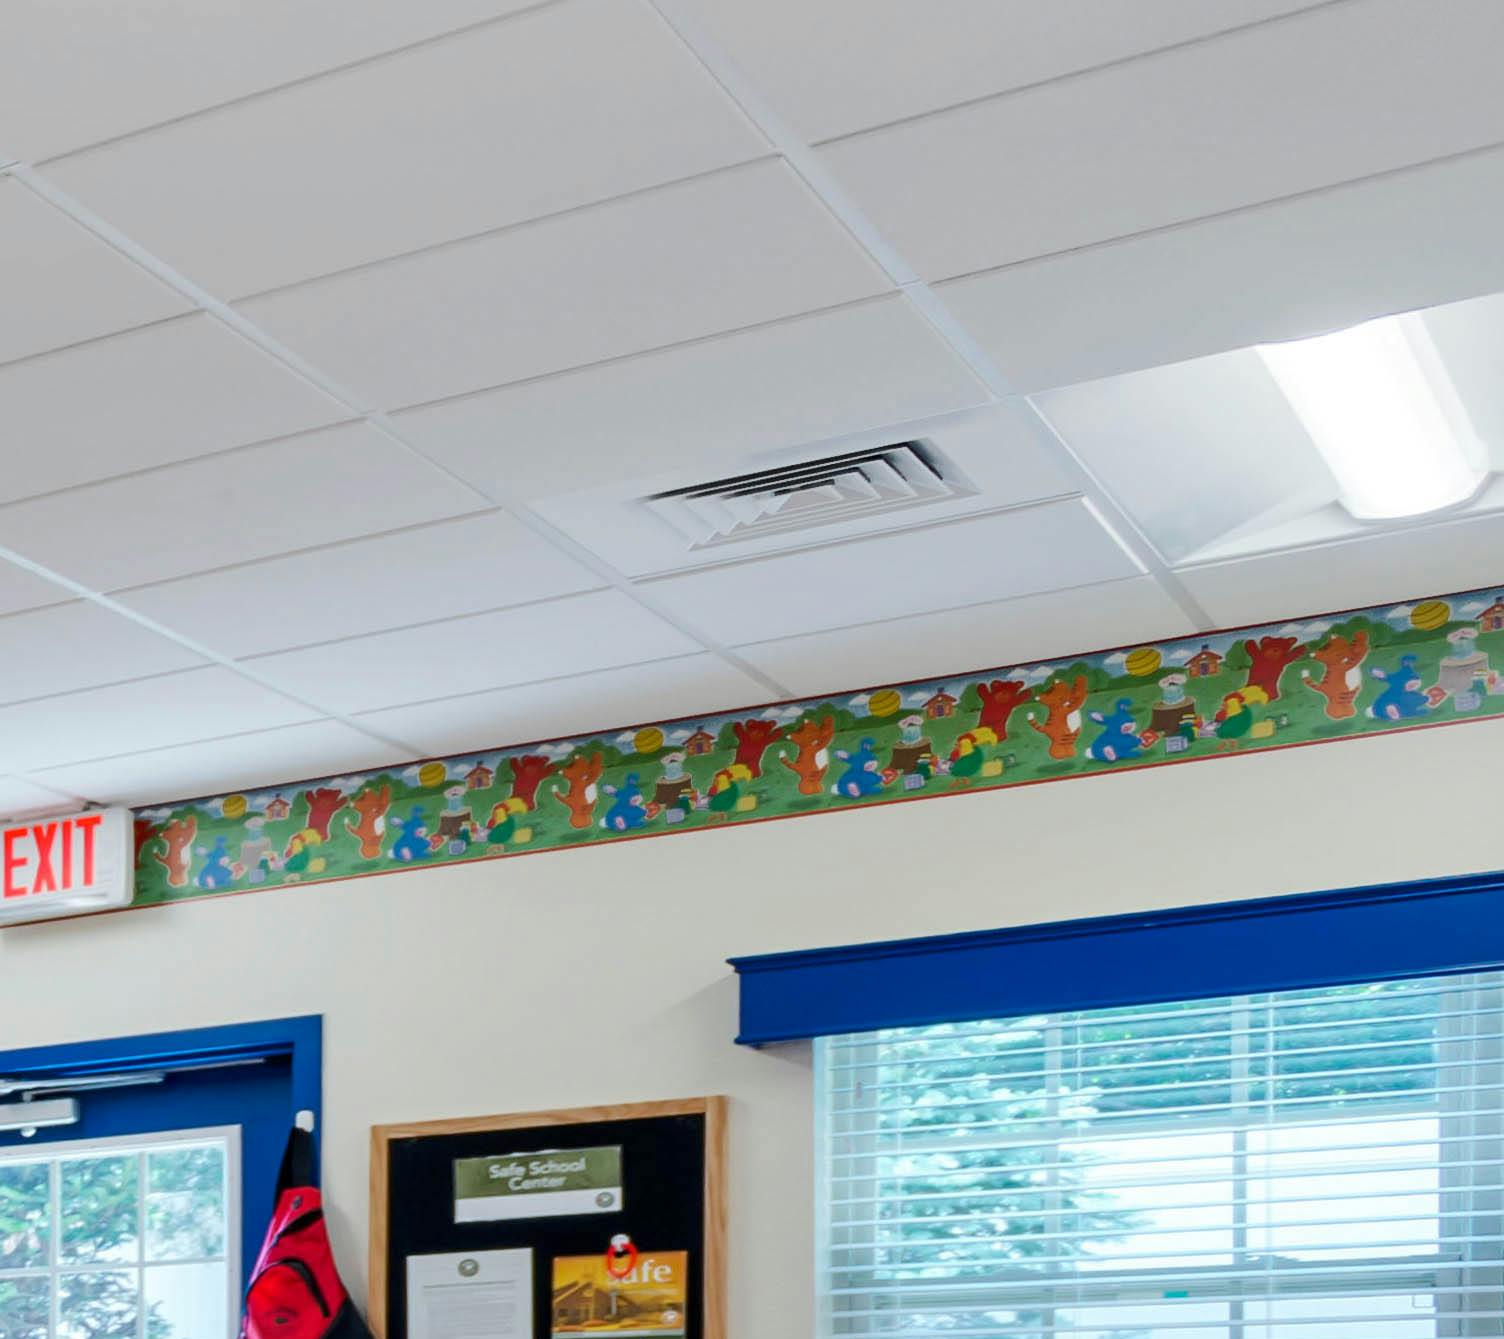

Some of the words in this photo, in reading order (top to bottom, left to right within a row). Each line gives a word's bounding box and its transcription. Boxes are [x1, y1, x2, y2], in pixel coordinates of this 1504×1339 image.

[3, 815, 102, 899] EXIT
[489, 1163, 525, 1179] Safe
[529, 1157, 586, 1176] School
[508, 1176, 567, 1191] Center
